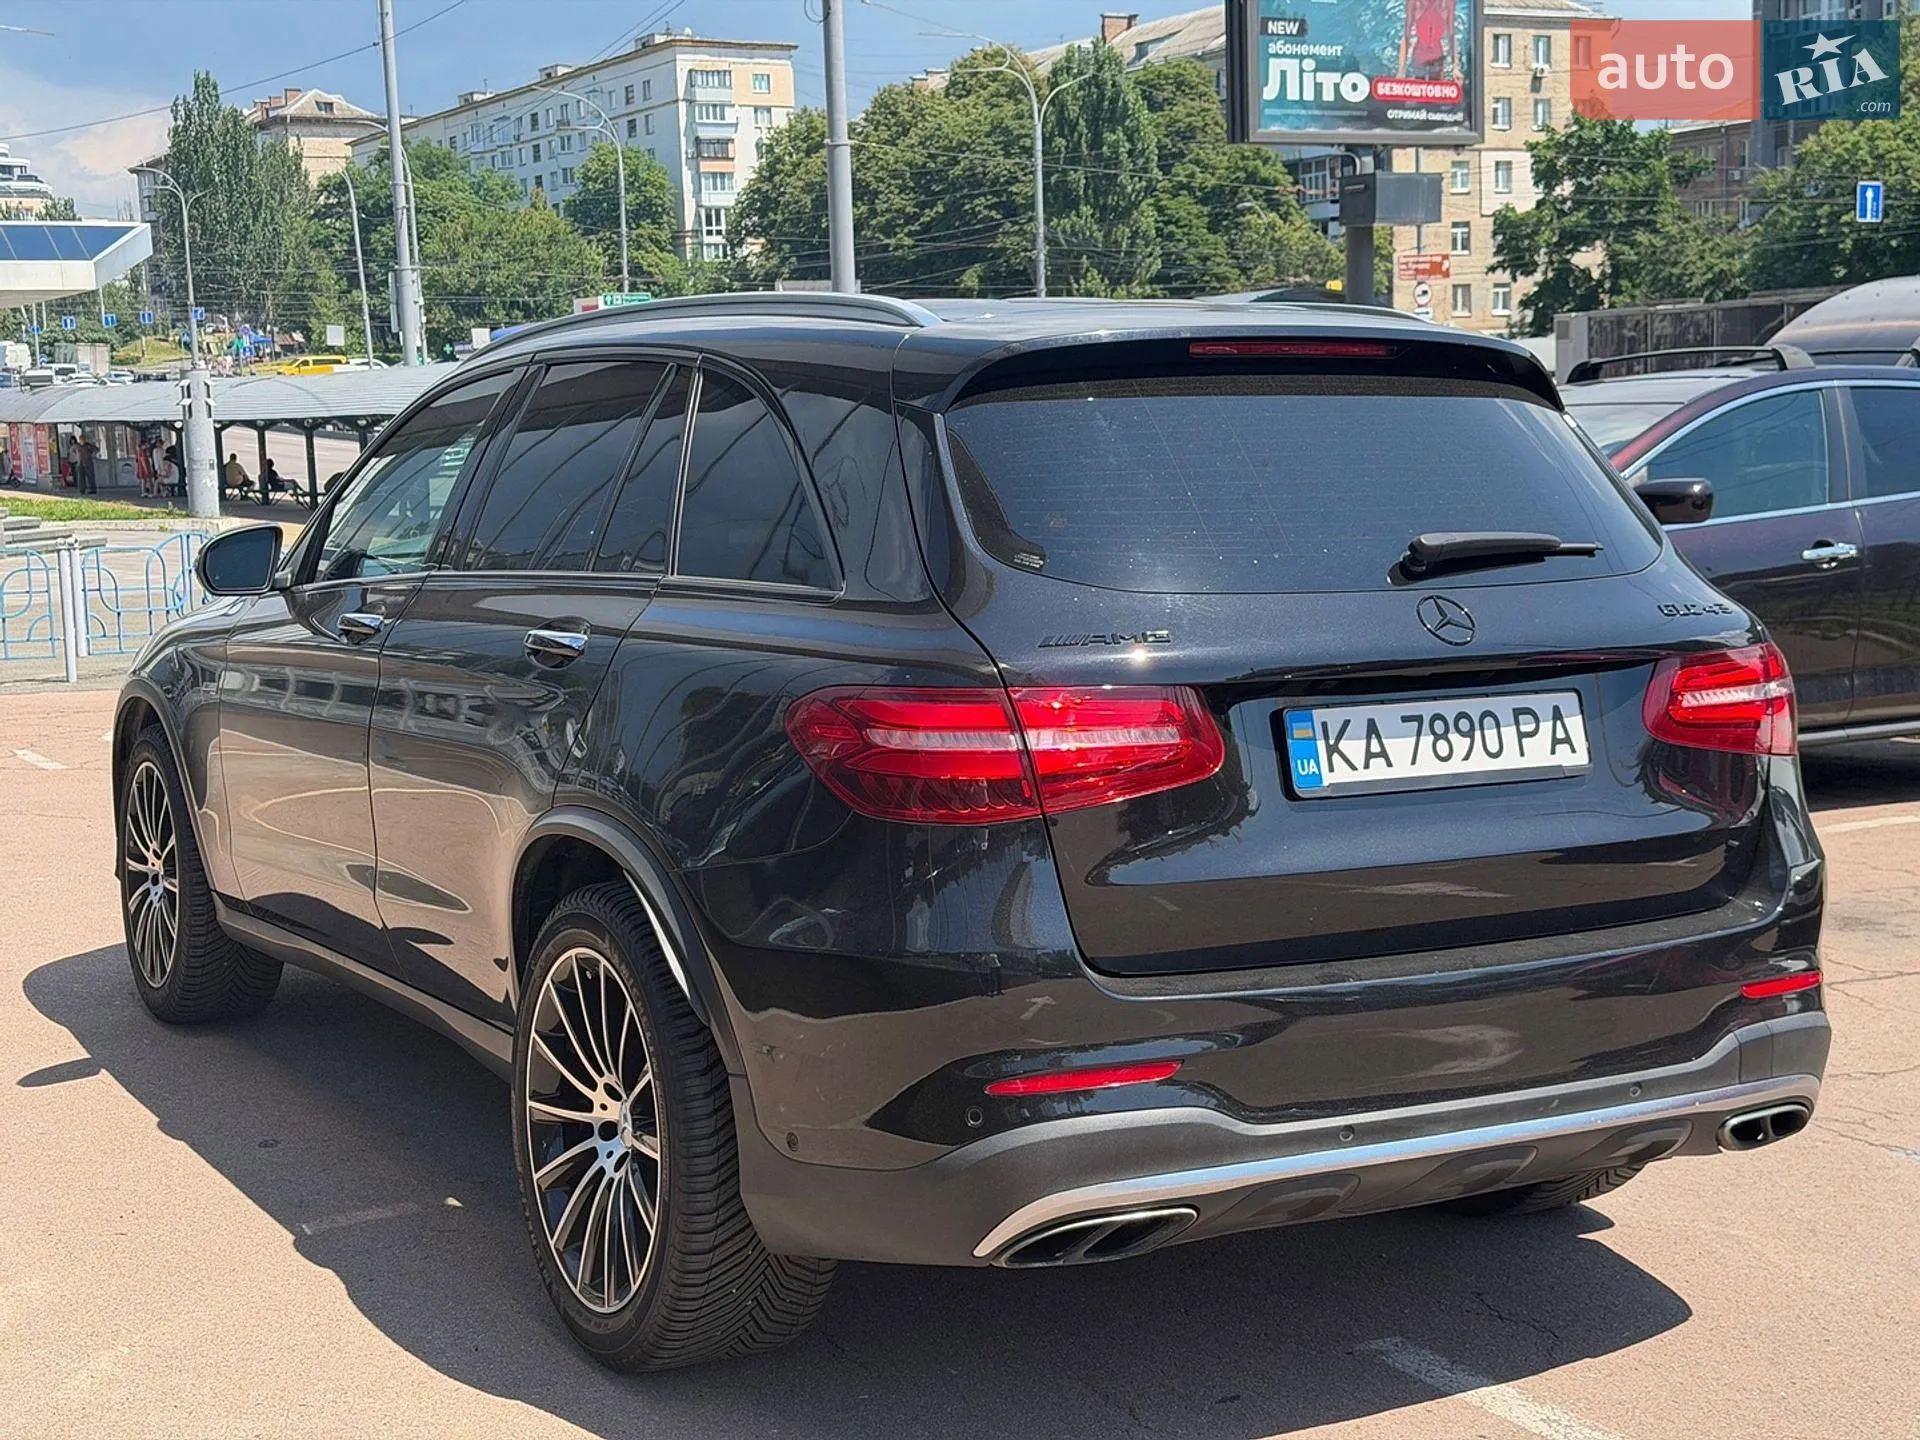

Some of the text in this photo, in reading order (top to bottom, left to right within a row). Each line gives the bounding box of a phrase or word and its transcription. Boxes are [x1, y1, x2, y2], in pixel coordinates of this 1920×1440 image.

[1267, 20, 1299, 35] NEW
[1268, 40, 1343, 56] абонемент
[1263, 58, 1370, 102] Літо
[1377, 82, 1458, 98] БЕЗКОШТОВНО
[1400, 709, 1504, 766] 7890
[1297, 759, 1319, 775] UA
